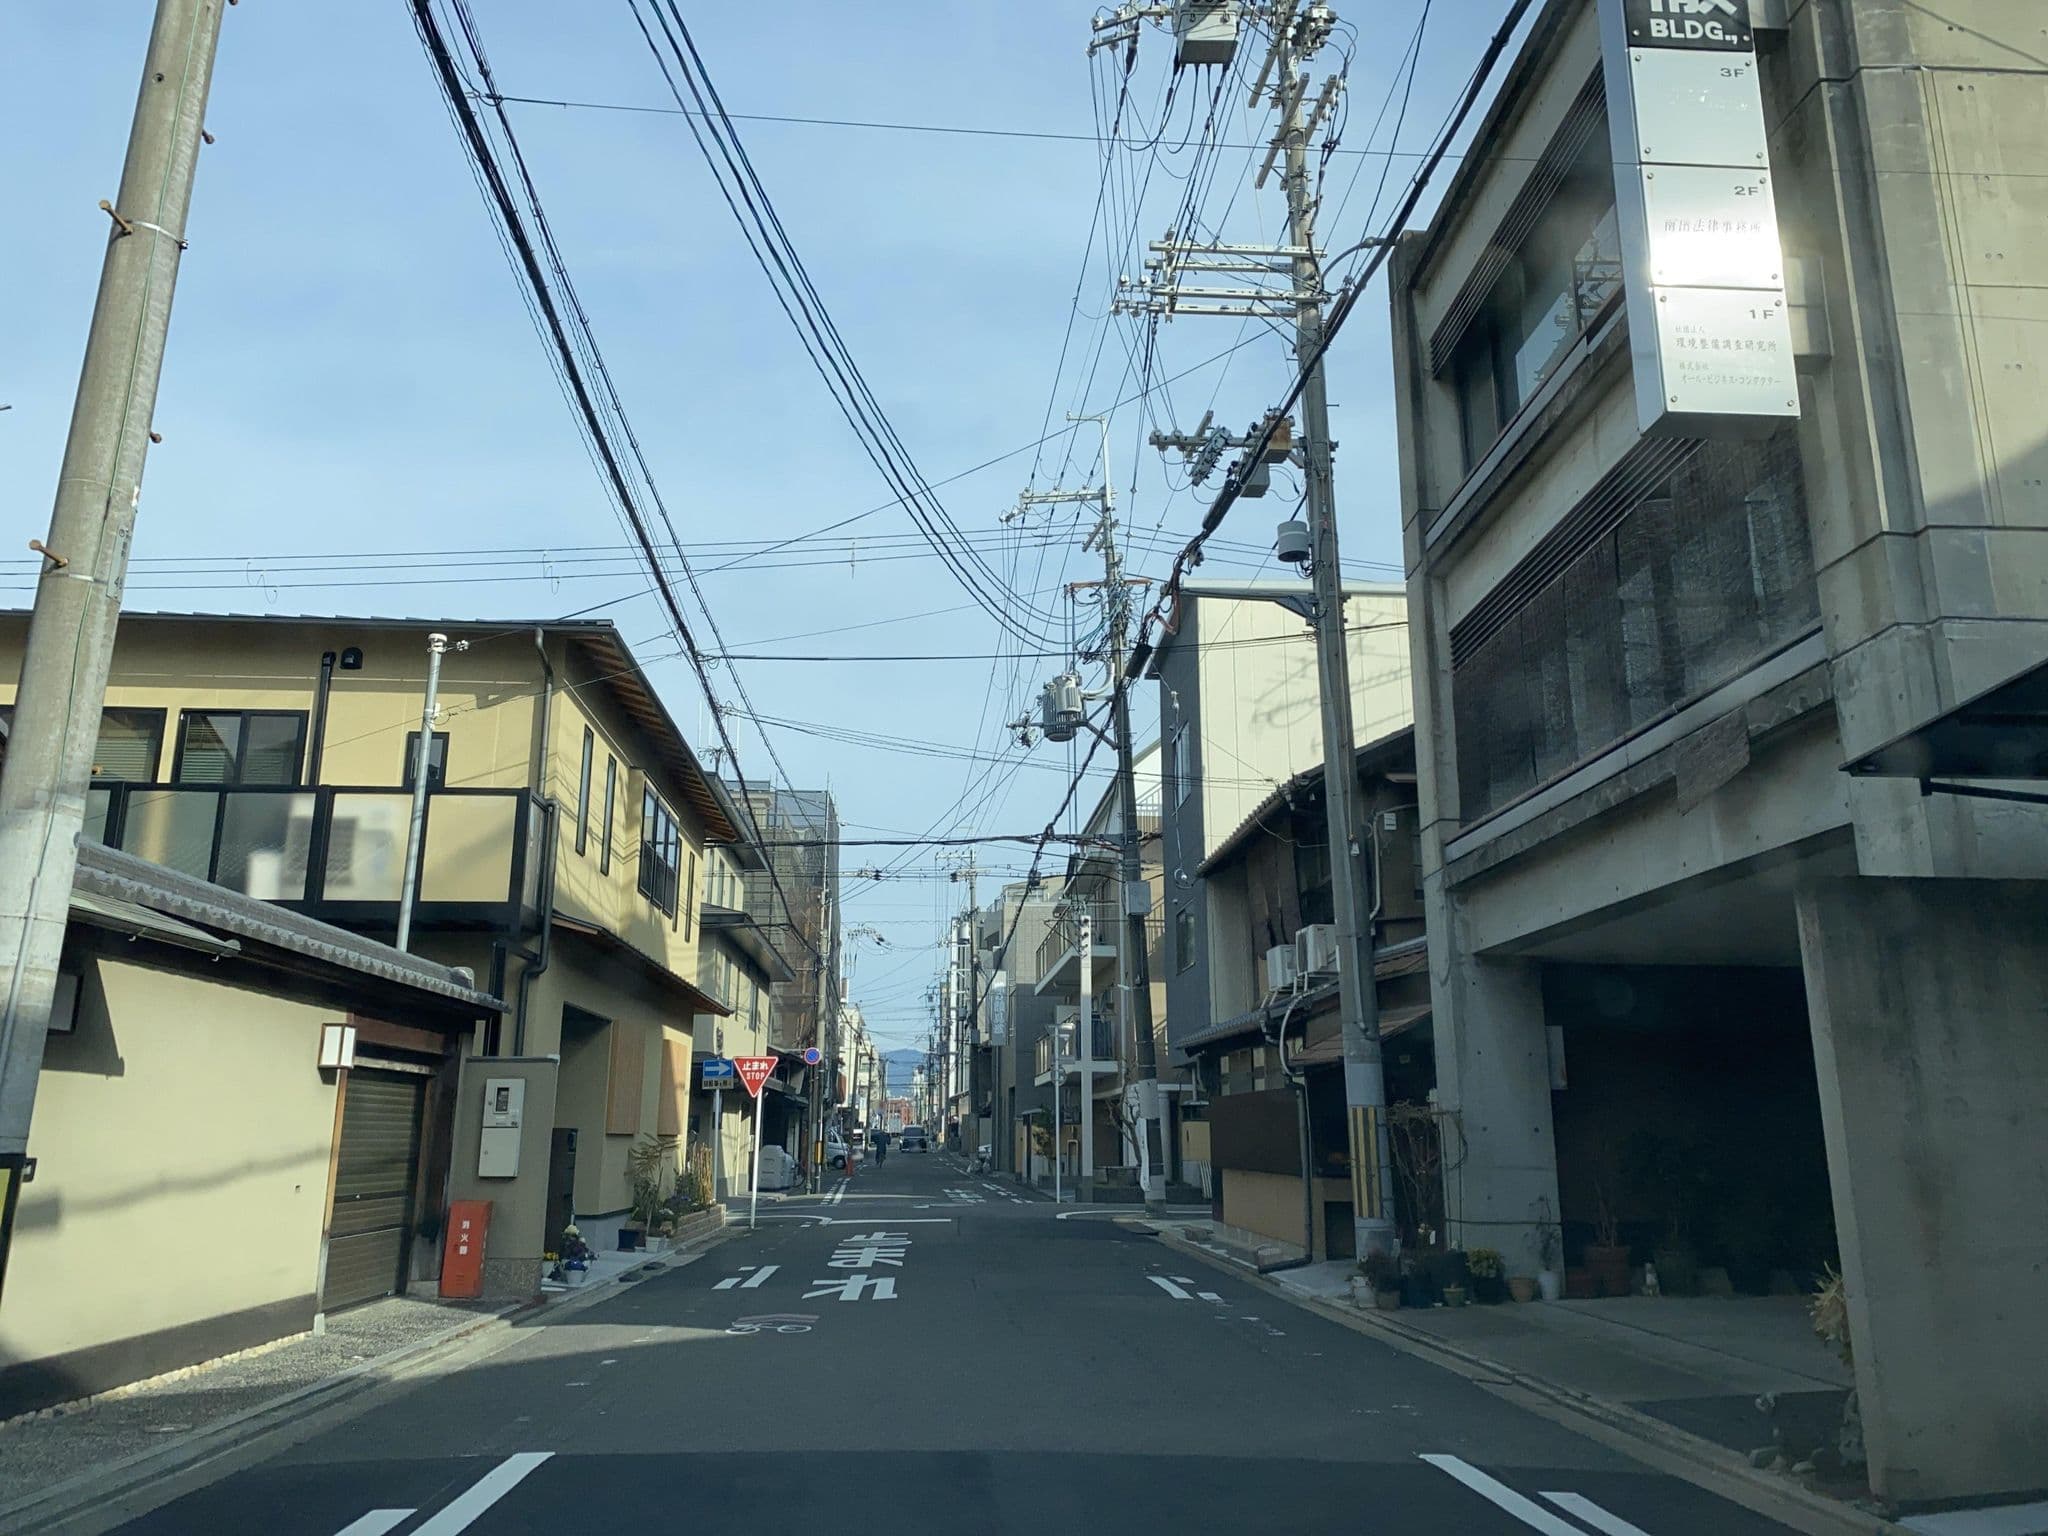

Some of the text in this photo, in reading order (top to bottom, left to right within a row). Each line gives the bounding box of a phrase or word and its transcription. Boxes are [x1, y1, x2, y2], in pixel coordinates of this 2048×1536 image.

[1719, 67, 1745, 78] 3F
[1733, 185, 1759, 196] 2F
[1748, 309, 1775, 320] 1F
[742, 1061, 769, 1071] 止まれ
[746, 1072, 766, 1081] STOP
